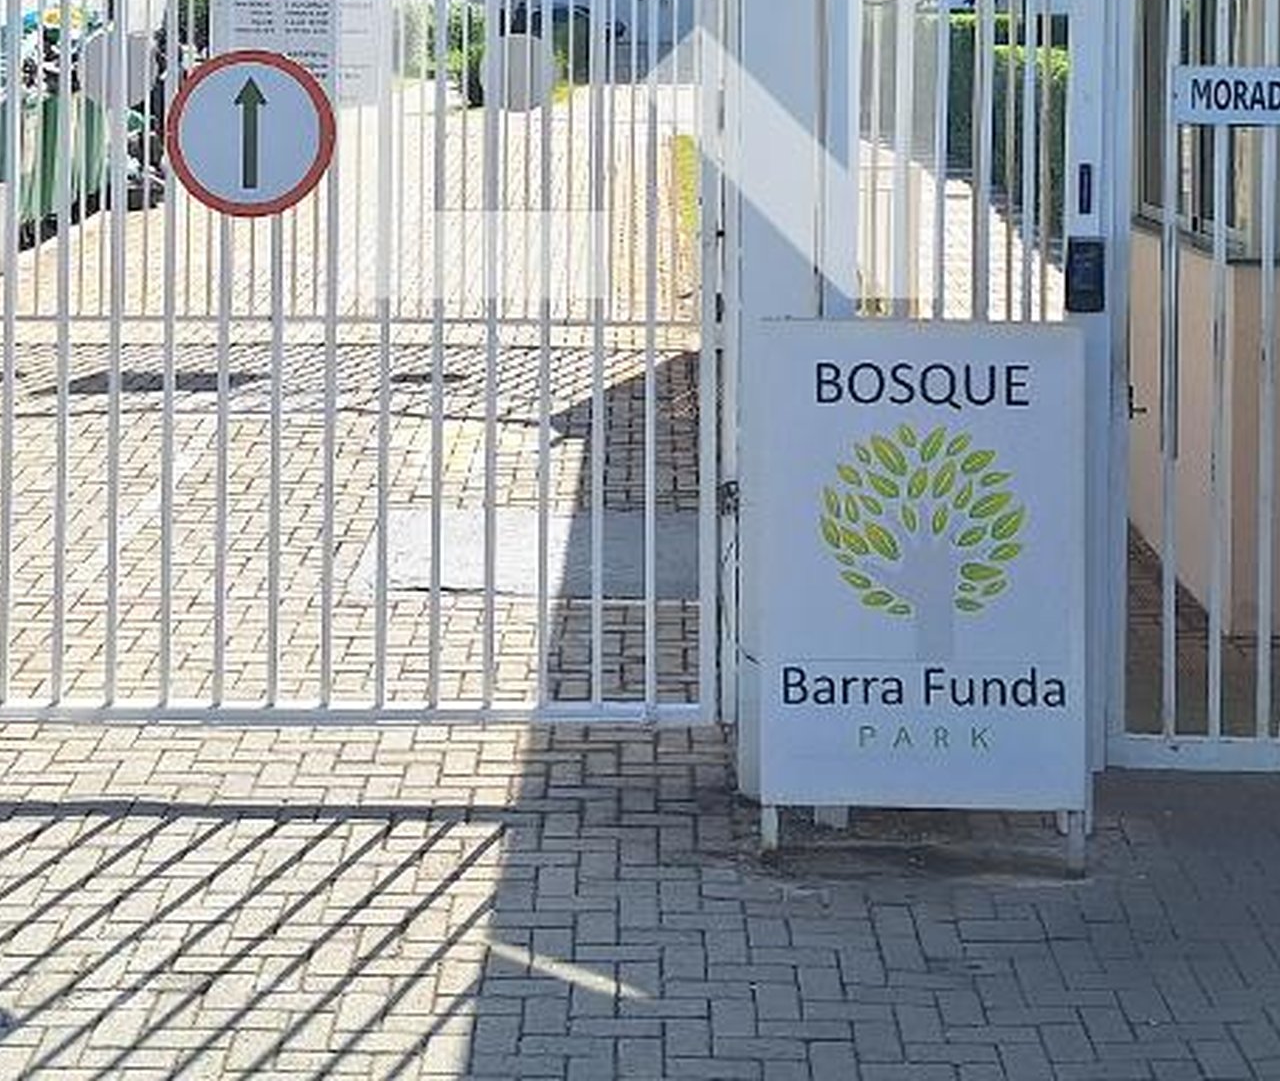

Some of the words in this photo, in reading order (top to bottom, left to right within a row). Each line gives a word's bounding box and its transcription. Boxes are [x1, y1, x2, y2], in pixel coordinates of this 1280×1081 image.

[816, 362, 1030, 410] BOSQUE
[782, 666, 904, 707] Barra
[923, 666, 1067, 708] Funda
[858, 725, 993, 751] PARK
